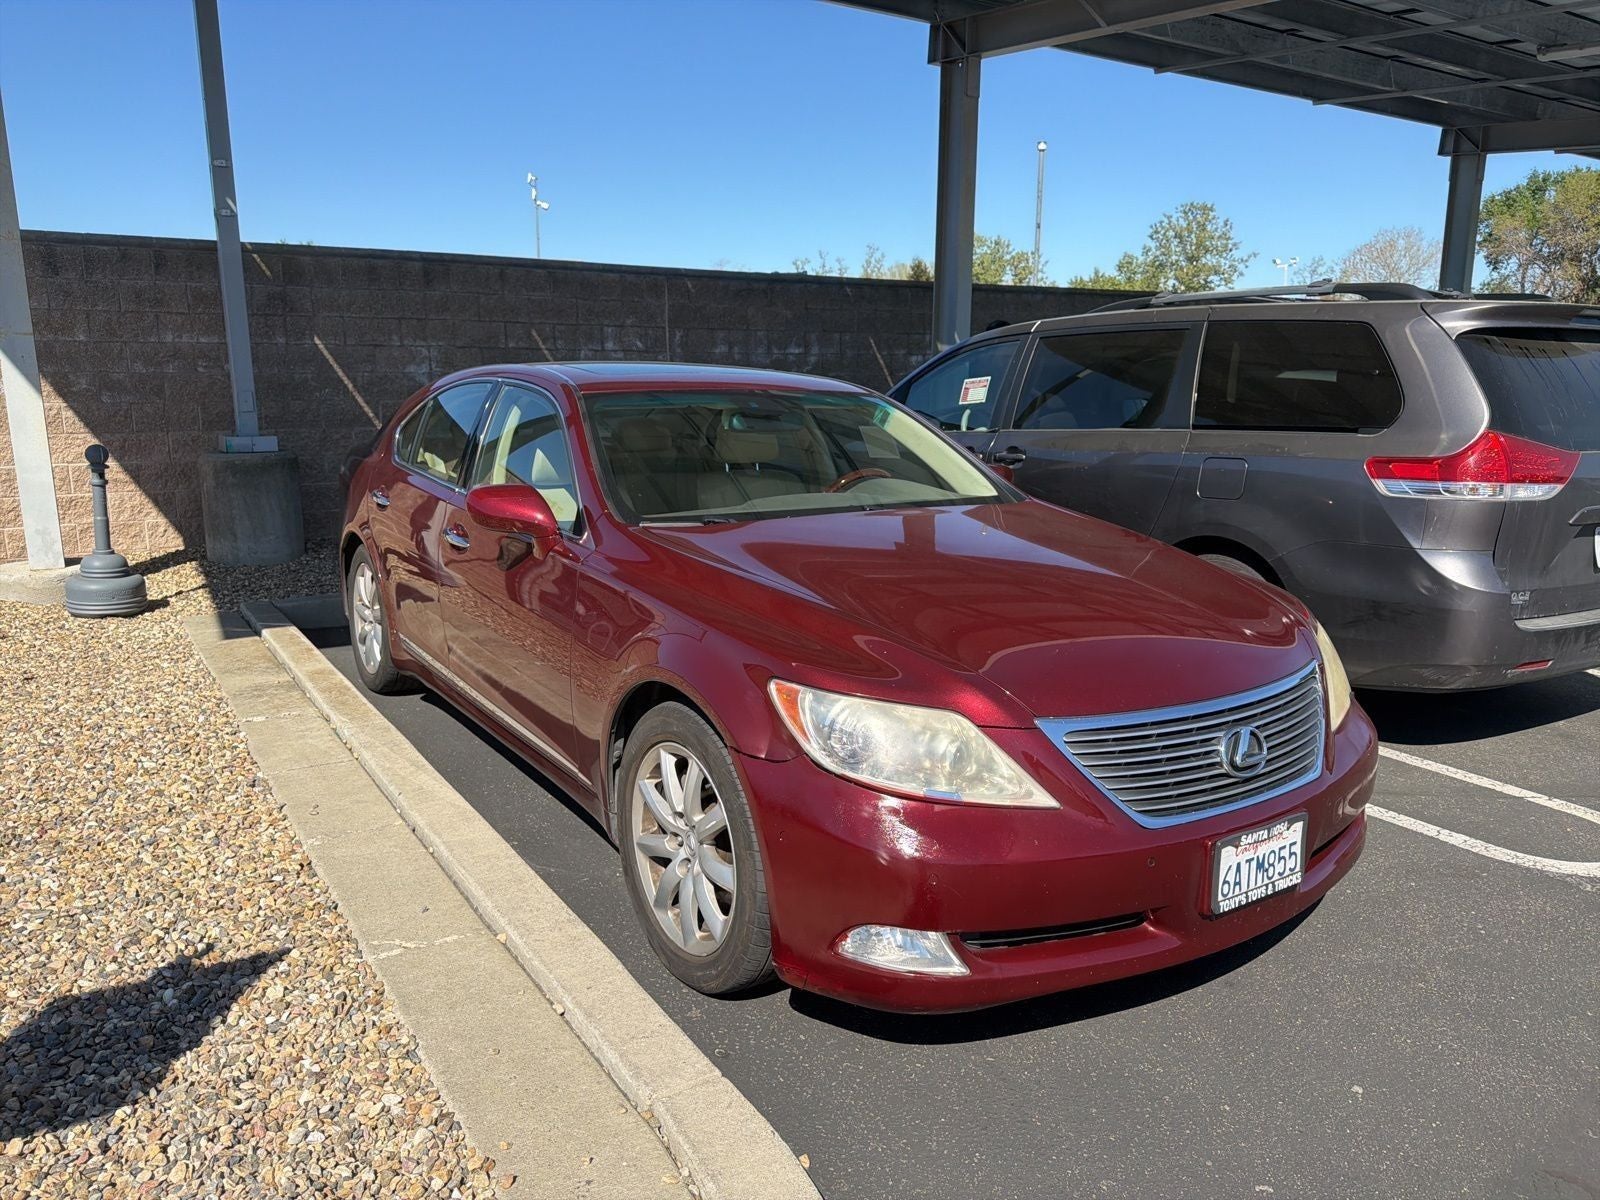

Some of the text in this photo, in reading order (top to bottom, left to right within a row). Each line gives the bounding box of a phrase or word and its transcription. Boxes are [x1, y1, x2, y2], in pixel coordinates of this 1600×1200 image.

[1240, 829, 1268, 846] SANTA
[1220, 841, 1298, 899] 6ATM855
[1219, 872, 1302, 913] TONY'S TOYS & TRUCKS
